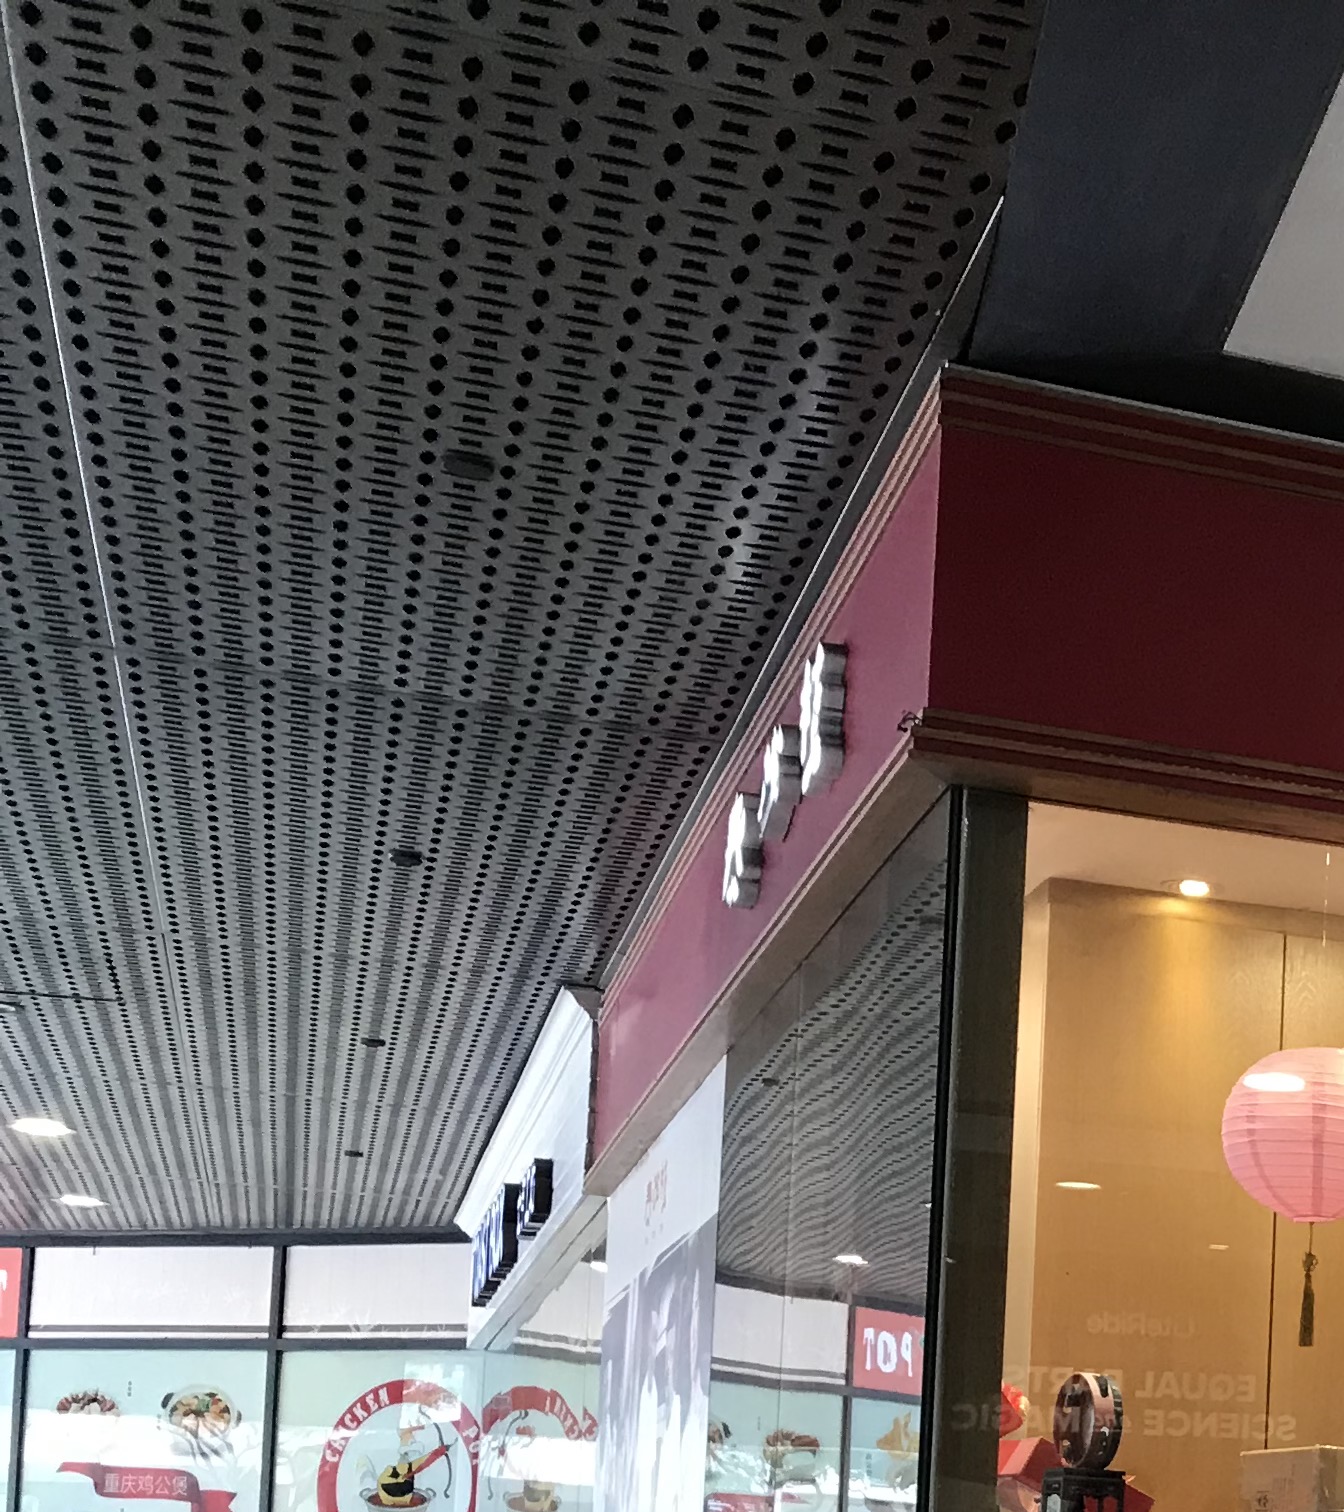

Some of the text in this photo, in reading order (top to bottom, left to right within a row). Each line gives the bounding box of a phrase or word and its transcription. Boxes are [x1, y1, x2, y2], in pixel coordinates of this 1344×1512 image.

[104, 1472, 188, 1496] 重庆鸡公煲
